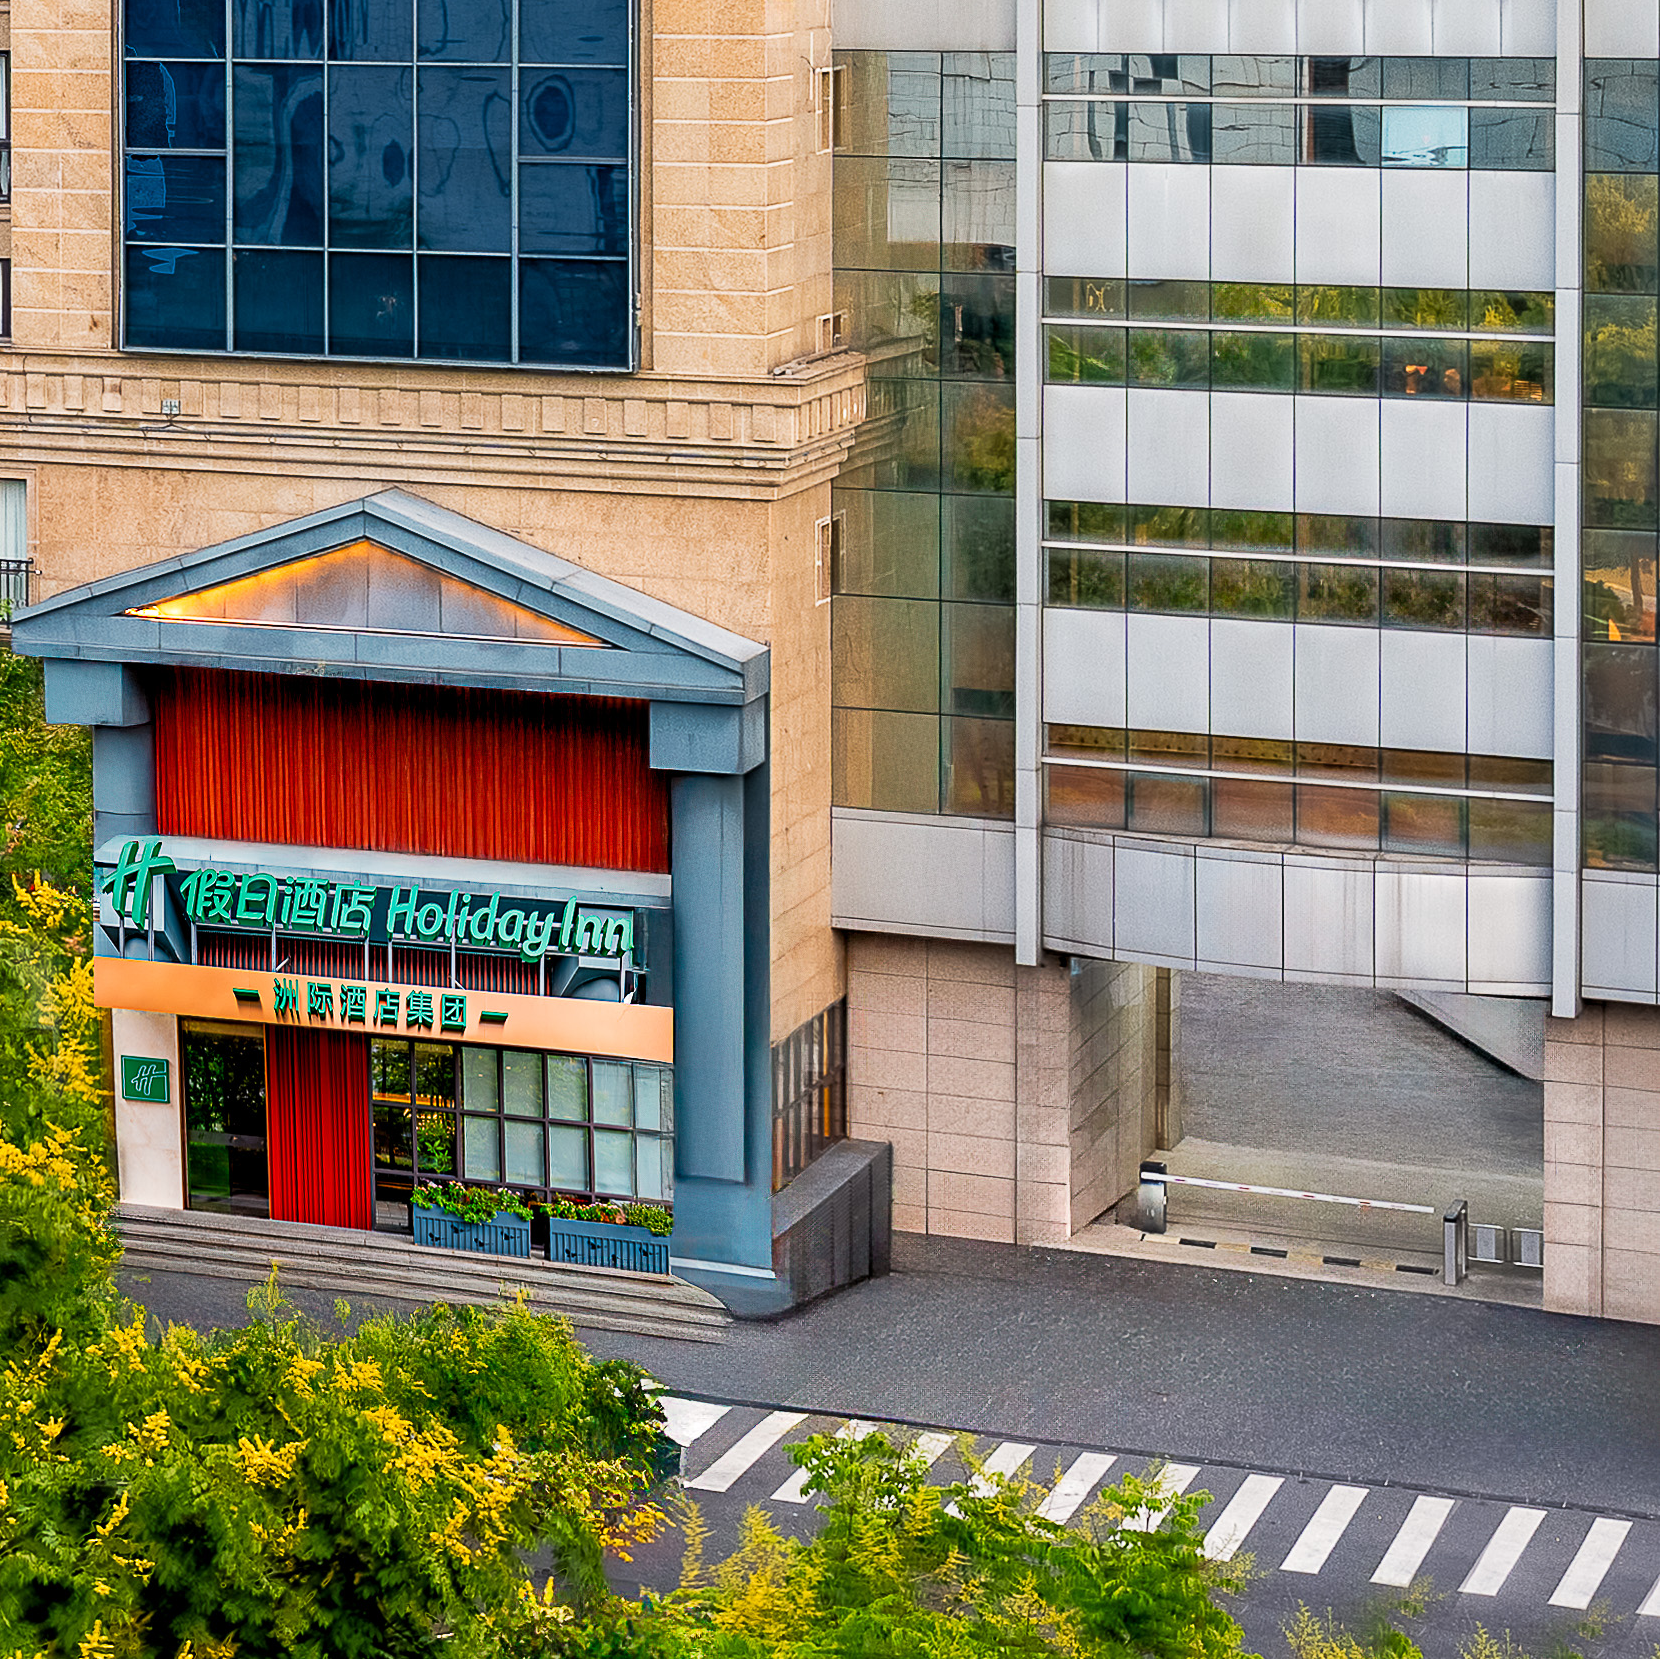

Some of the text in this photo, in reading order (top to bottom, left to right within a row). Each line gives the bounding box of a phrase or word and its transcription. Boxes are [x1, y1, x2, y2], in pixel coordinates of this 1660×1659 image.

[180, 868, 377, 938] 假日酒店
[386, 884, 634, 963] Holiday Inn
[273, 978, 467, 1033] 洲际酒店集团
